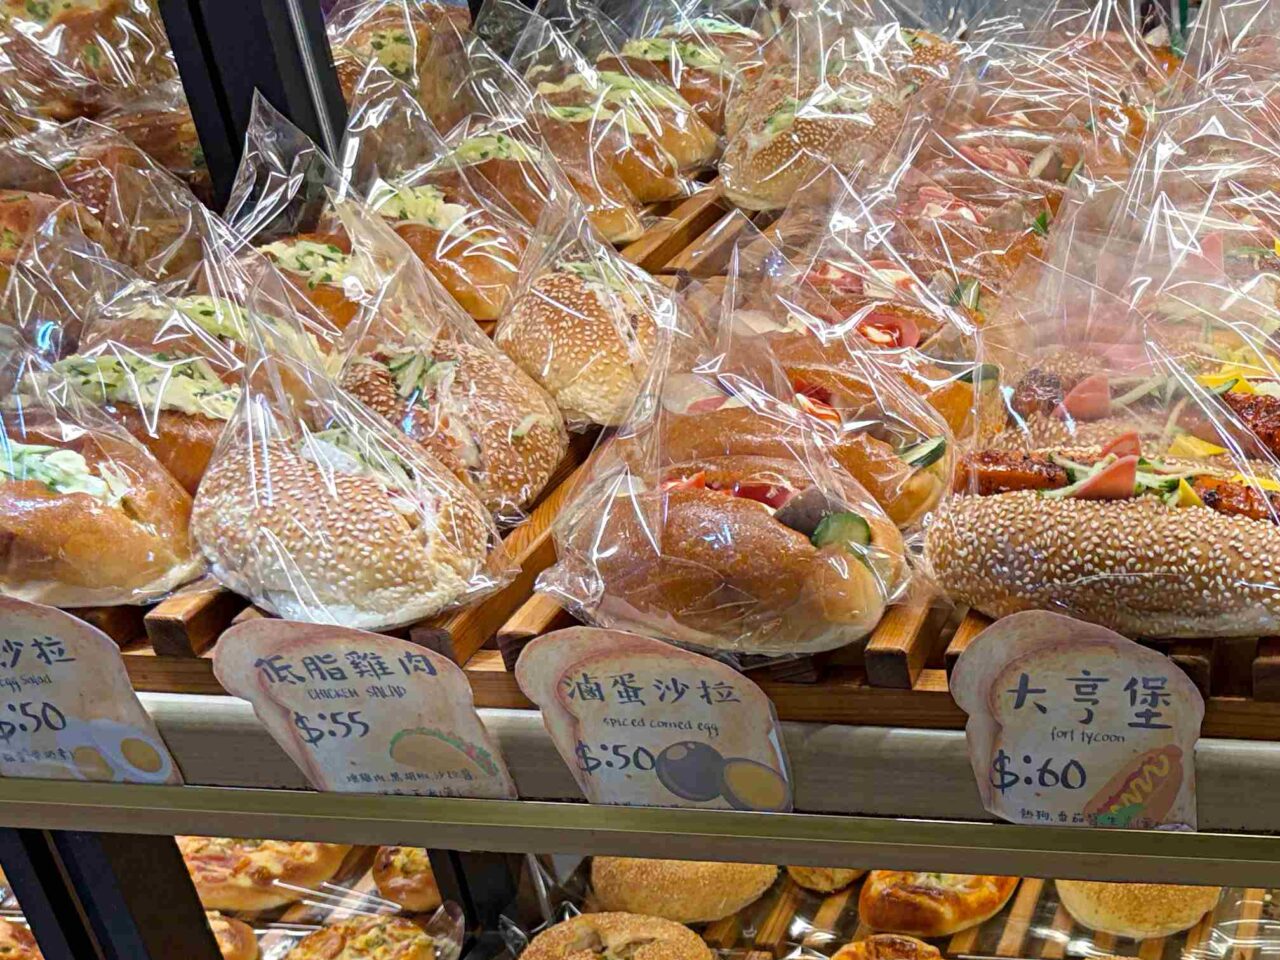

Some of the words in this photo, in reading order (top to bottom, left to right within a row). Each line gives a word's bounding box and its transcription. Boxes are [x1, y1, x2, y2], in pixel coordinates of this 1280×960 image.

[255, 651, 437, 685] 低脂雞肉
[562, 673, 741, 705] 滷蛋沙拉
[1006, 670, 1172, 729] 大亨堡
[294, 711, 369, 747] $:55
[1051, 726, 1074, 741] fort
[1080, 728, 1126, 744] tycoon
[575, 740, 656, 776] $:50
[990, 749, 1087, 796] $:60
